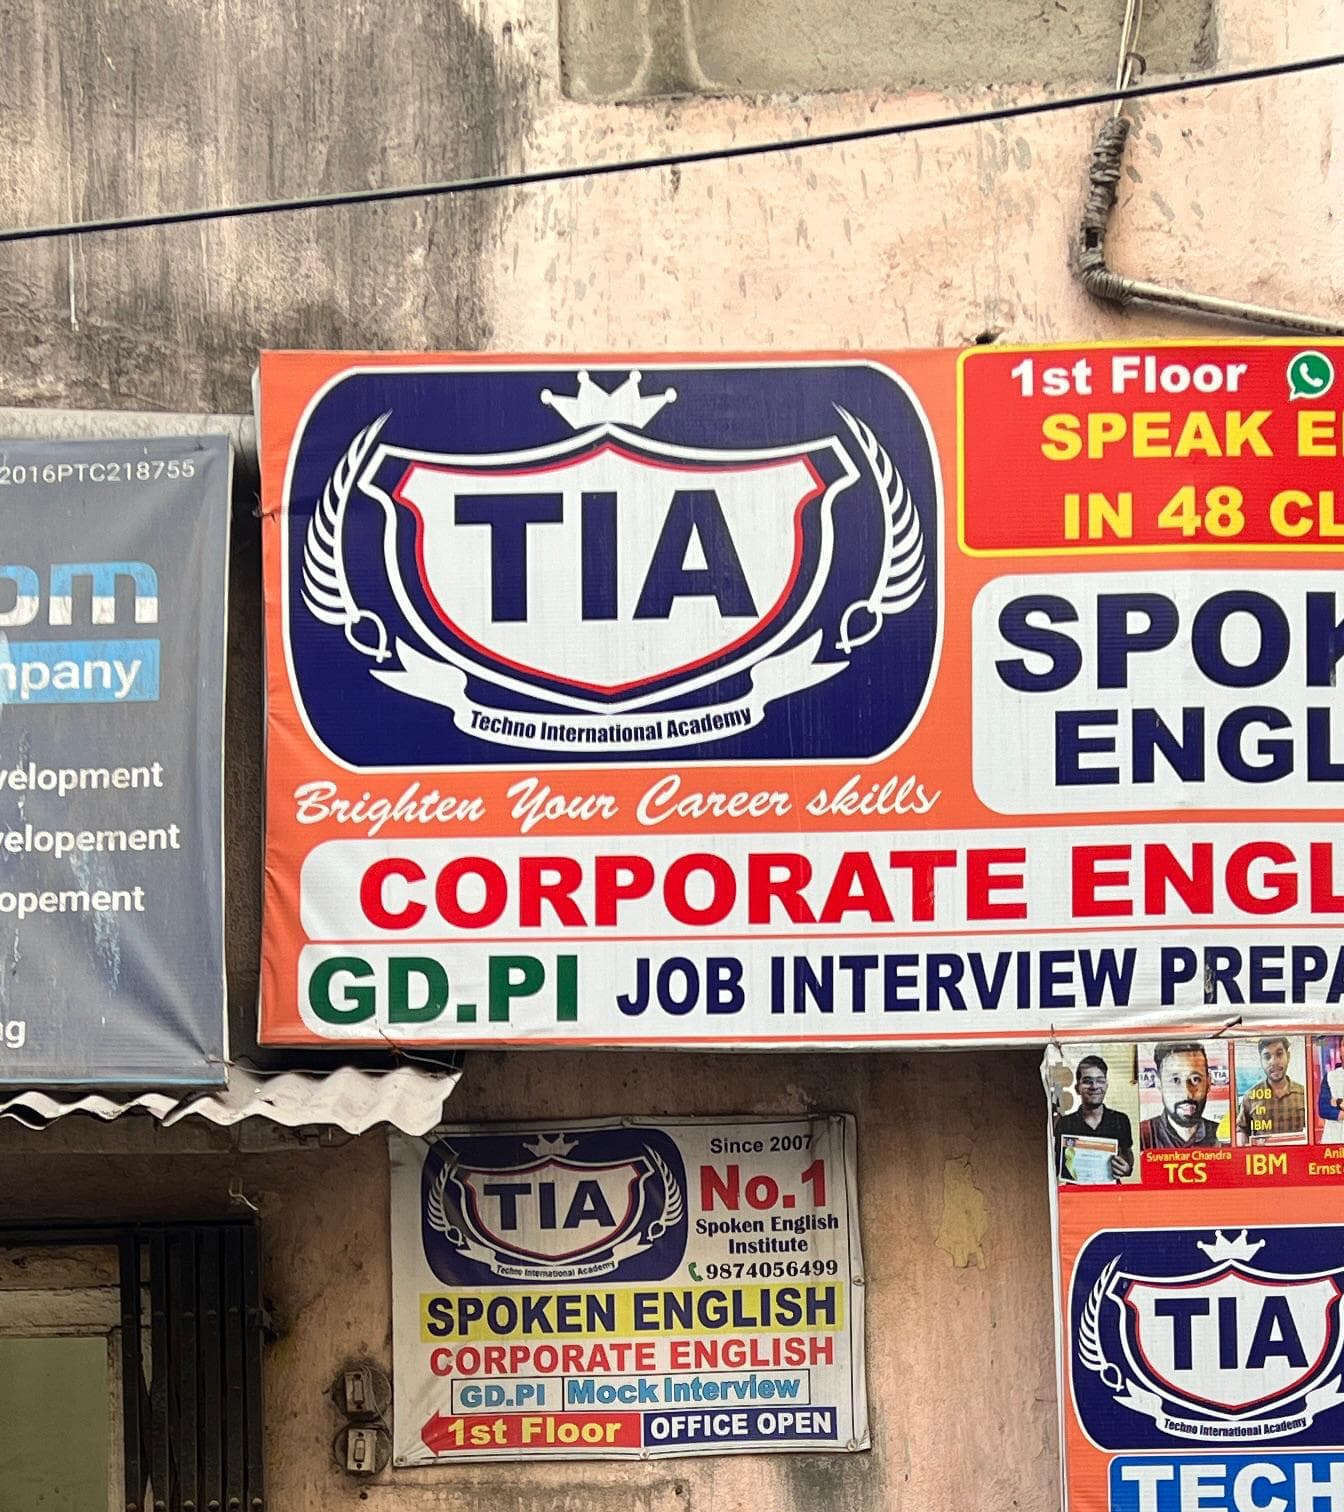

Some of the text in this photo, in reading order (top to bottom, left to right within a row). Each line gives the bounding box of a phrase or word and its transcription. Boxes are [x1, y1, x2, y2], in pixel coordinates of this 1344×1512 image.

[1012, 357, 1247, 398] 1st Floor
[1041, 411, 1273, 461] SPEAK
[1064, 492, 1132, 540] IN
[1158, 486, 1245, 537] 48
[454, 489, 759, 624] TIA
[471, 708, 752, 743] Techno International Academy
[294, 773, 942, 838] Brighten Your Career skills
[359, 847, 1028, 931] CORPORATE
[308, 954, 578, 1026] GD.PI
[616, 956, 745, 1017] JOB
[771, 947, 1138, 1015] INTERVIEW
[700, 1159, 828, 1211] No.1
[1163, 1162, 1207, 1184] TCS
[1245, 1153, 1288, 1176] IBM
[483, 1180, 617, 1230] TIA
[695, 1214, 839, 1236] Spoken English
[705, 1260, 838, 1280] 9874056499
[728, 1236, 808, 1254] Institute
[426, 1286, 836, 1336] SPOKEN ENGLISH
[1155, 1295, 1309, 1371] TIA
[650, 1412, 831, 1438] OFFICE OPEN
